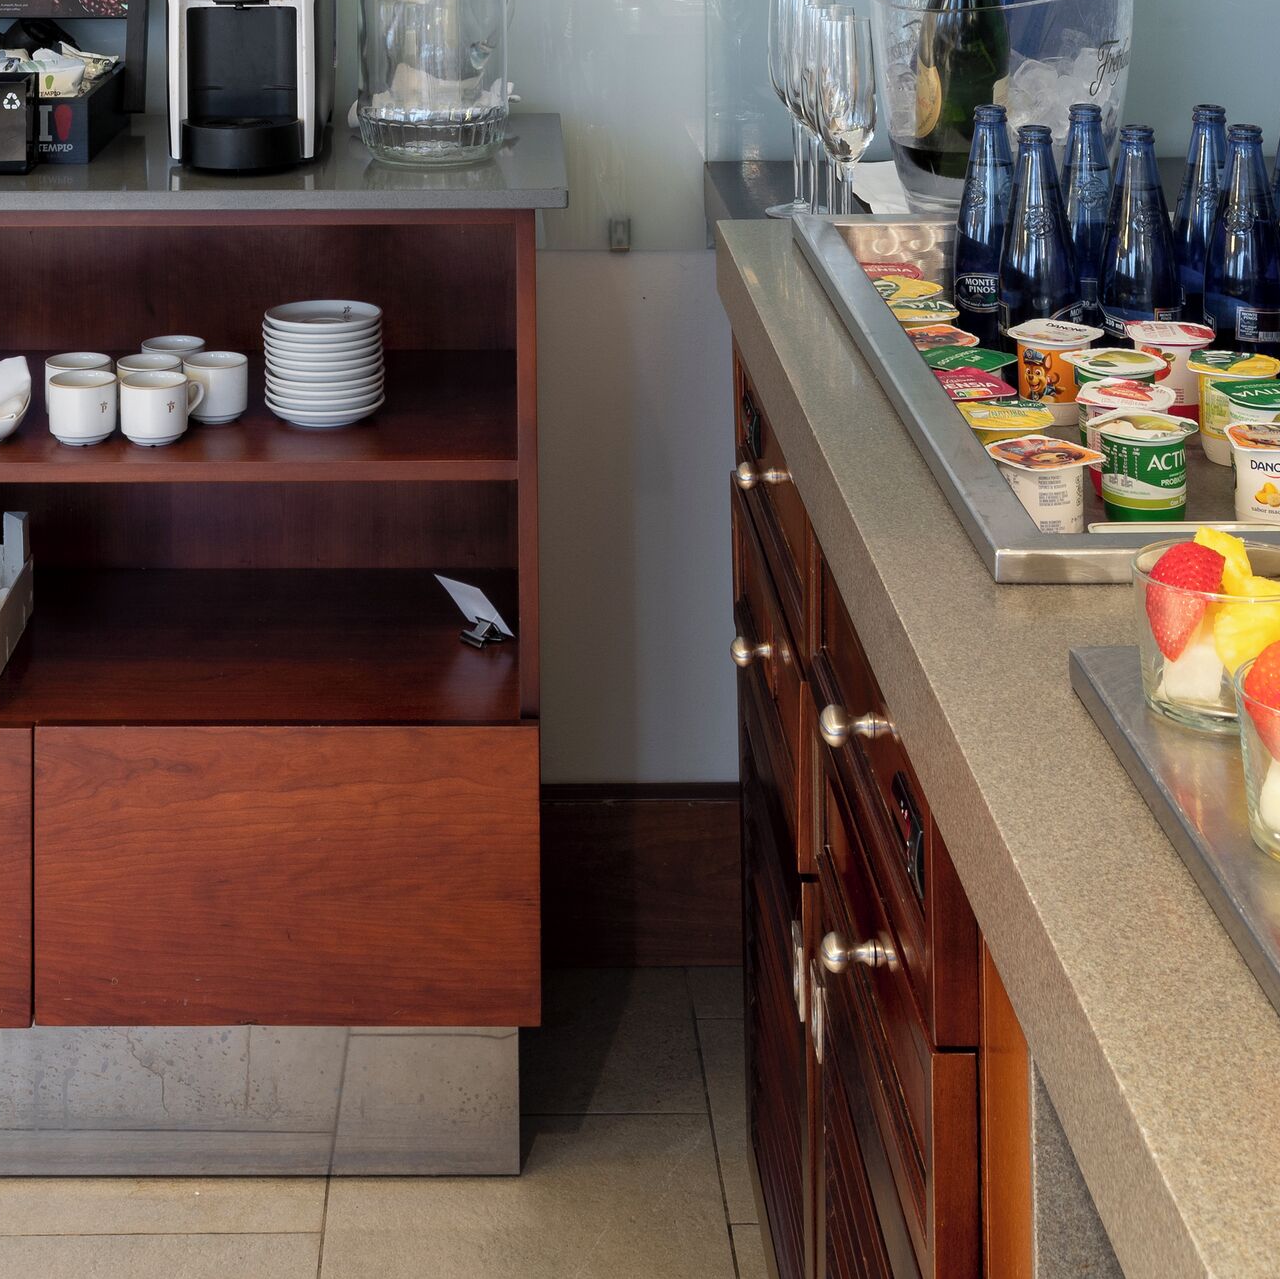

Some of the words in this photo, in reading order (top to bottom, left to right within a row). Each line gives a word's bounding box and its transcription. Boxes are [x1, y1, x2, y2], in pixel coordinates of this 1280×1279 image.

[965, 278, 995, 286] MONTE
[969, 286, 996, 294] PINOS
[1046, 322, 1087, 332] DANONE
[1115, 322, 1123, 330] ml
[1251, 506, 1267, 514] sabor
